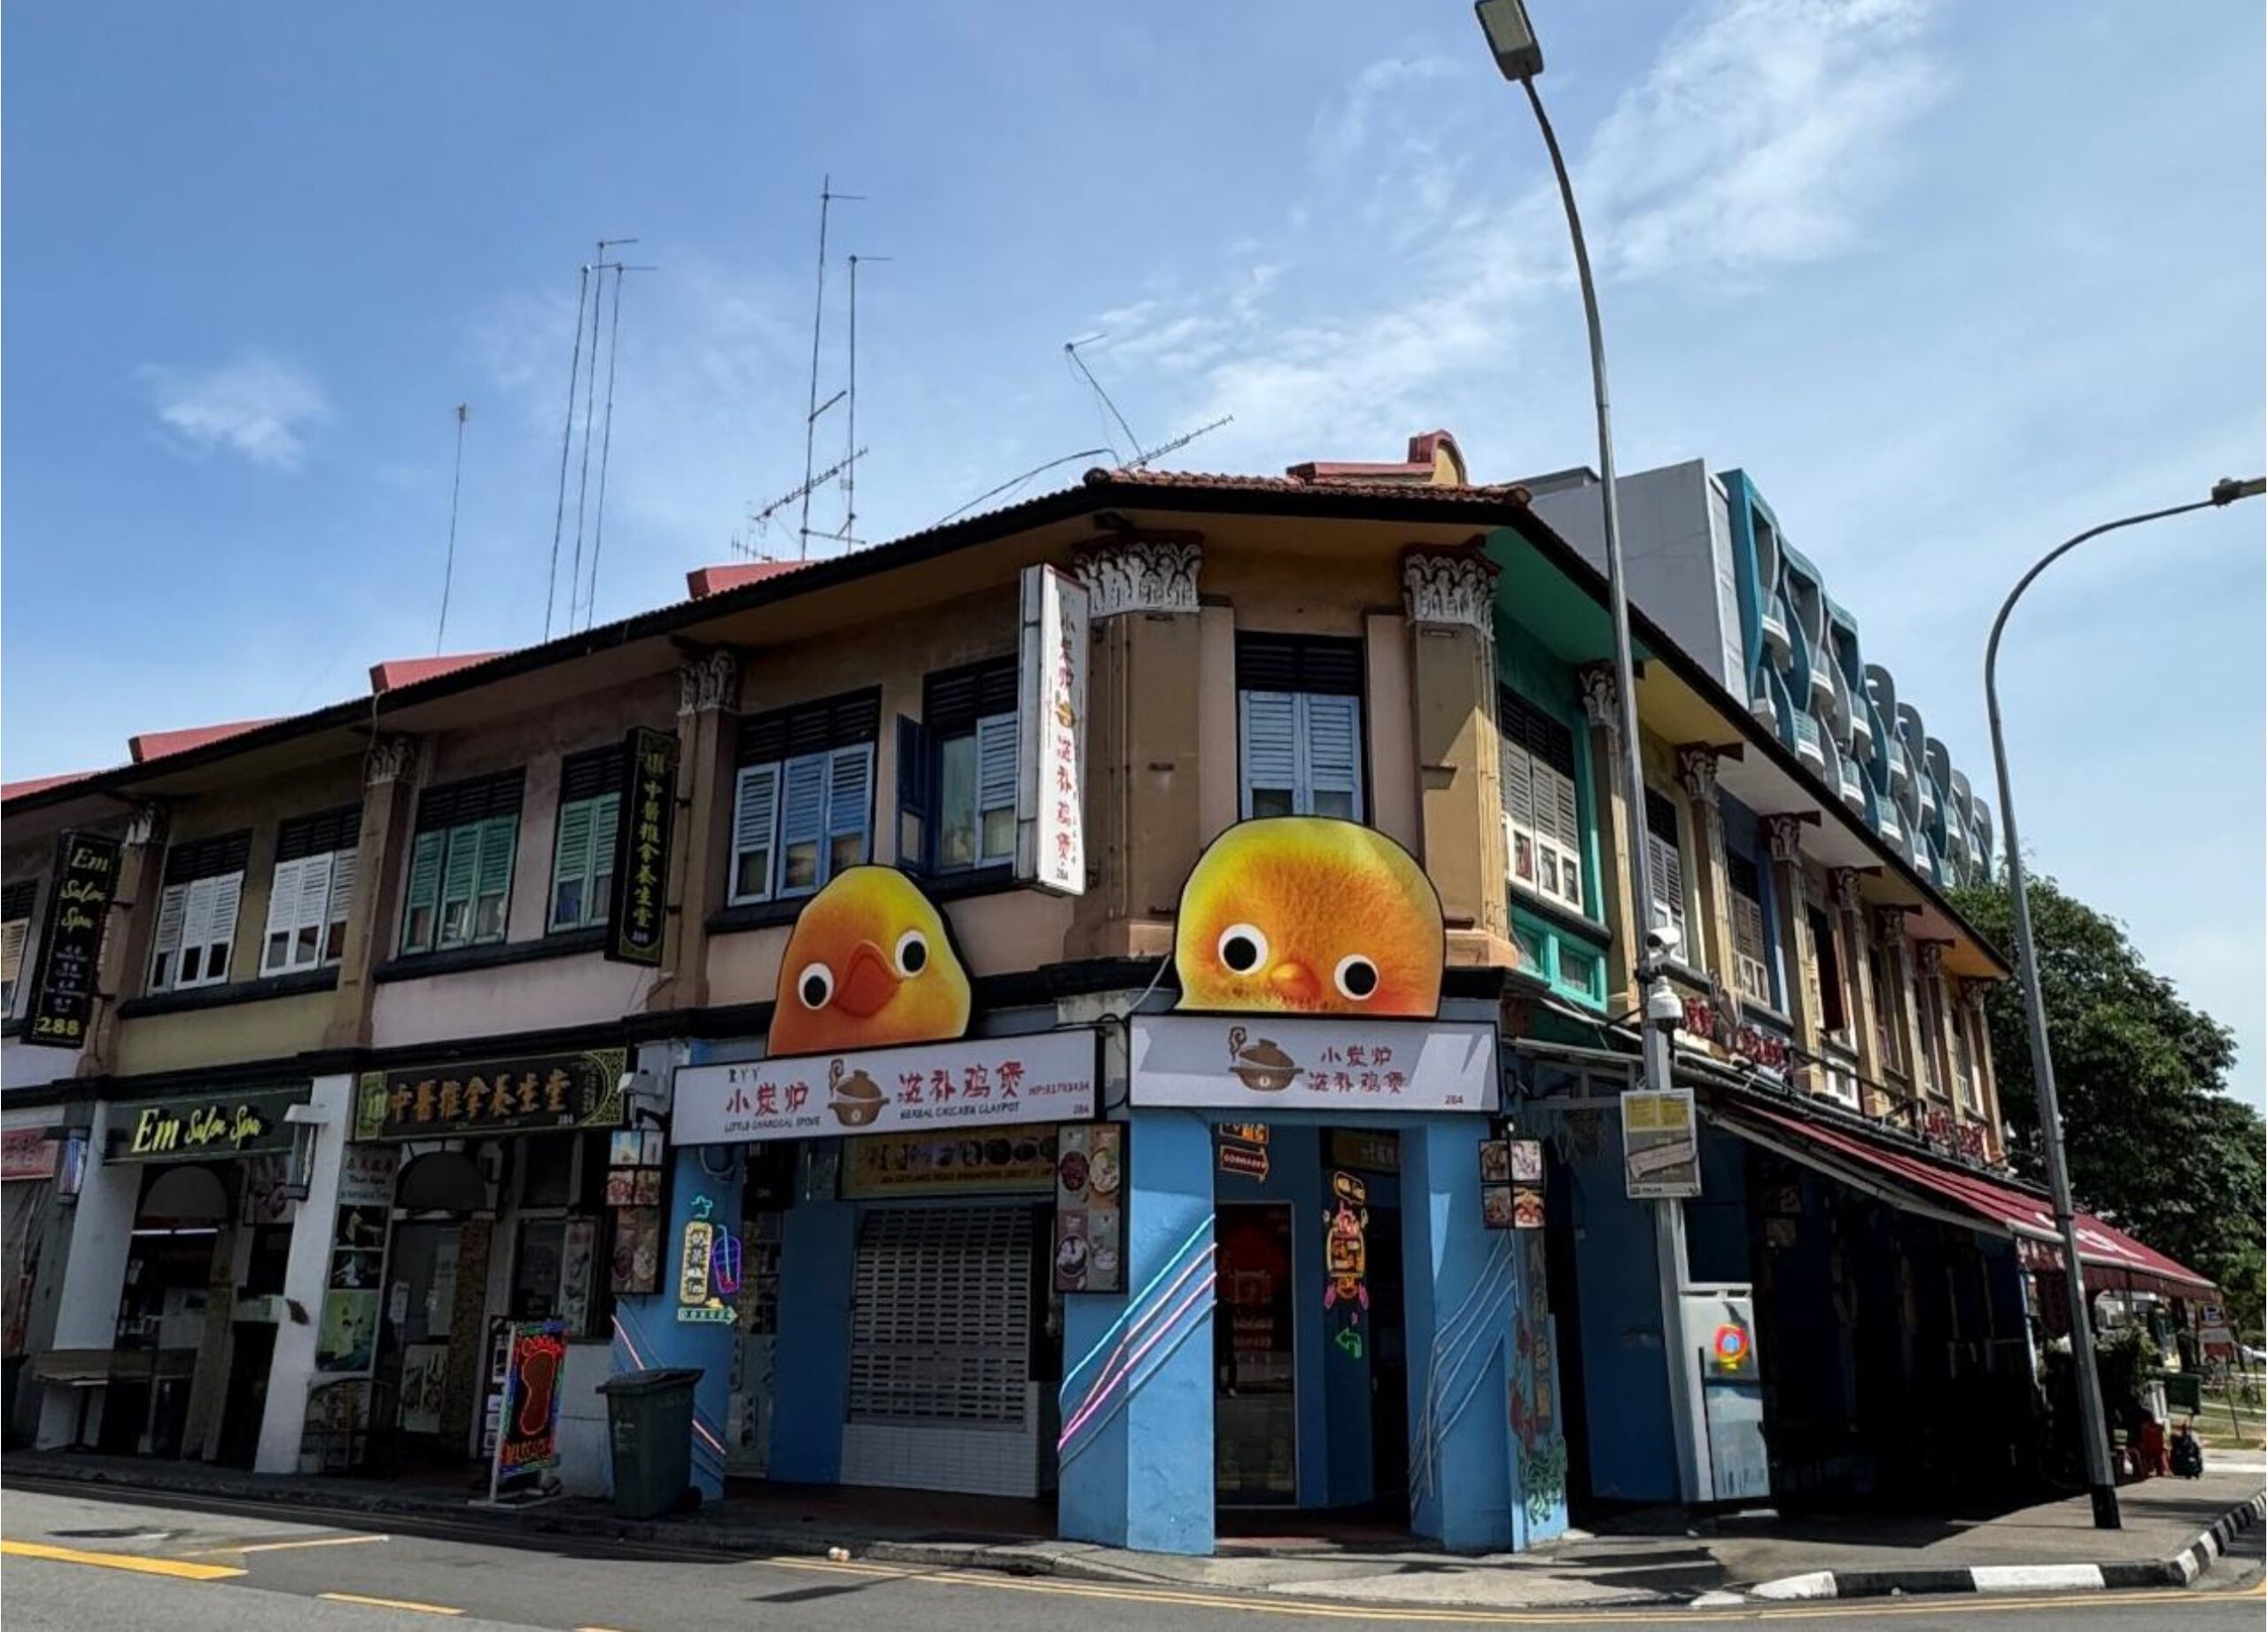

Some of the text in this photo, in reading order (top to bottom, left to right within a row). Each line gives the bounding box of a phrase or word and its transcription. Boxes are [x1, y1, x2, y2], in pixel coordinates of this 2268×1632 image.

[72, 848, 109, 873] Em
[38, 1016, 81, 1036] 288
[1321, 1045, 1393, 1068] 小炭炉
[726, 1061, 1025, 1116] 小炭炉 滋补鸡煲
[130, 1107, 180, 1153] Em
